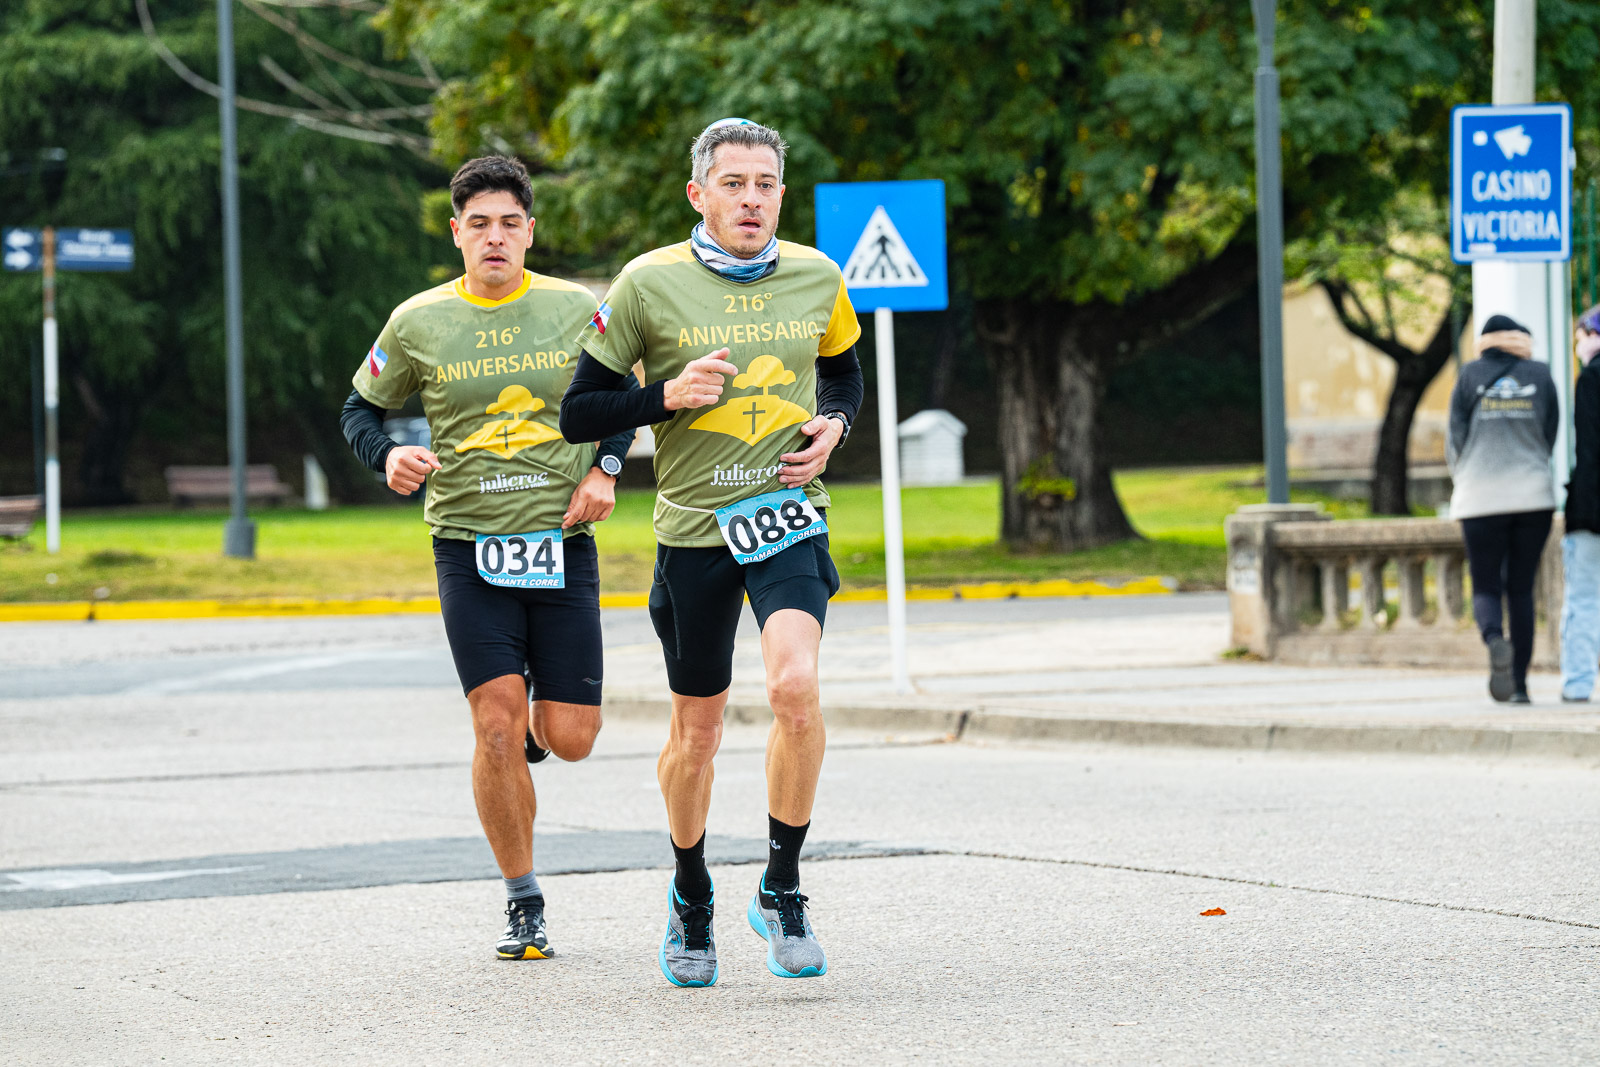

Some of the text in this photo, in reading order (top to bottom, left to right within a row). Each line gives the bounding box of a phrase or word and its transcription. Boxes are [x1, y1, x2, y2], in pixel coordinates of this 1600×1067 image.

[1472, 169, 1552, 202] CASINO
[1462, 210, 1561, 241] VICTORIA
[723, 292, 773, 313] 216°
[475, 326, 521, 349] 216°
[678, 320, 820, 348] ANIVERSARIO
[436, 350, 570, 384] ANIVERSARIO
[479, 471, 548, 494] julicroc
[728, 498, 813, 554] 088
[481, 536, 556, 576] 034
[743, 526, 823, 562] DIAMANTE CORRE
[483, 576, 560, 586] DIAMANTE CORRE
